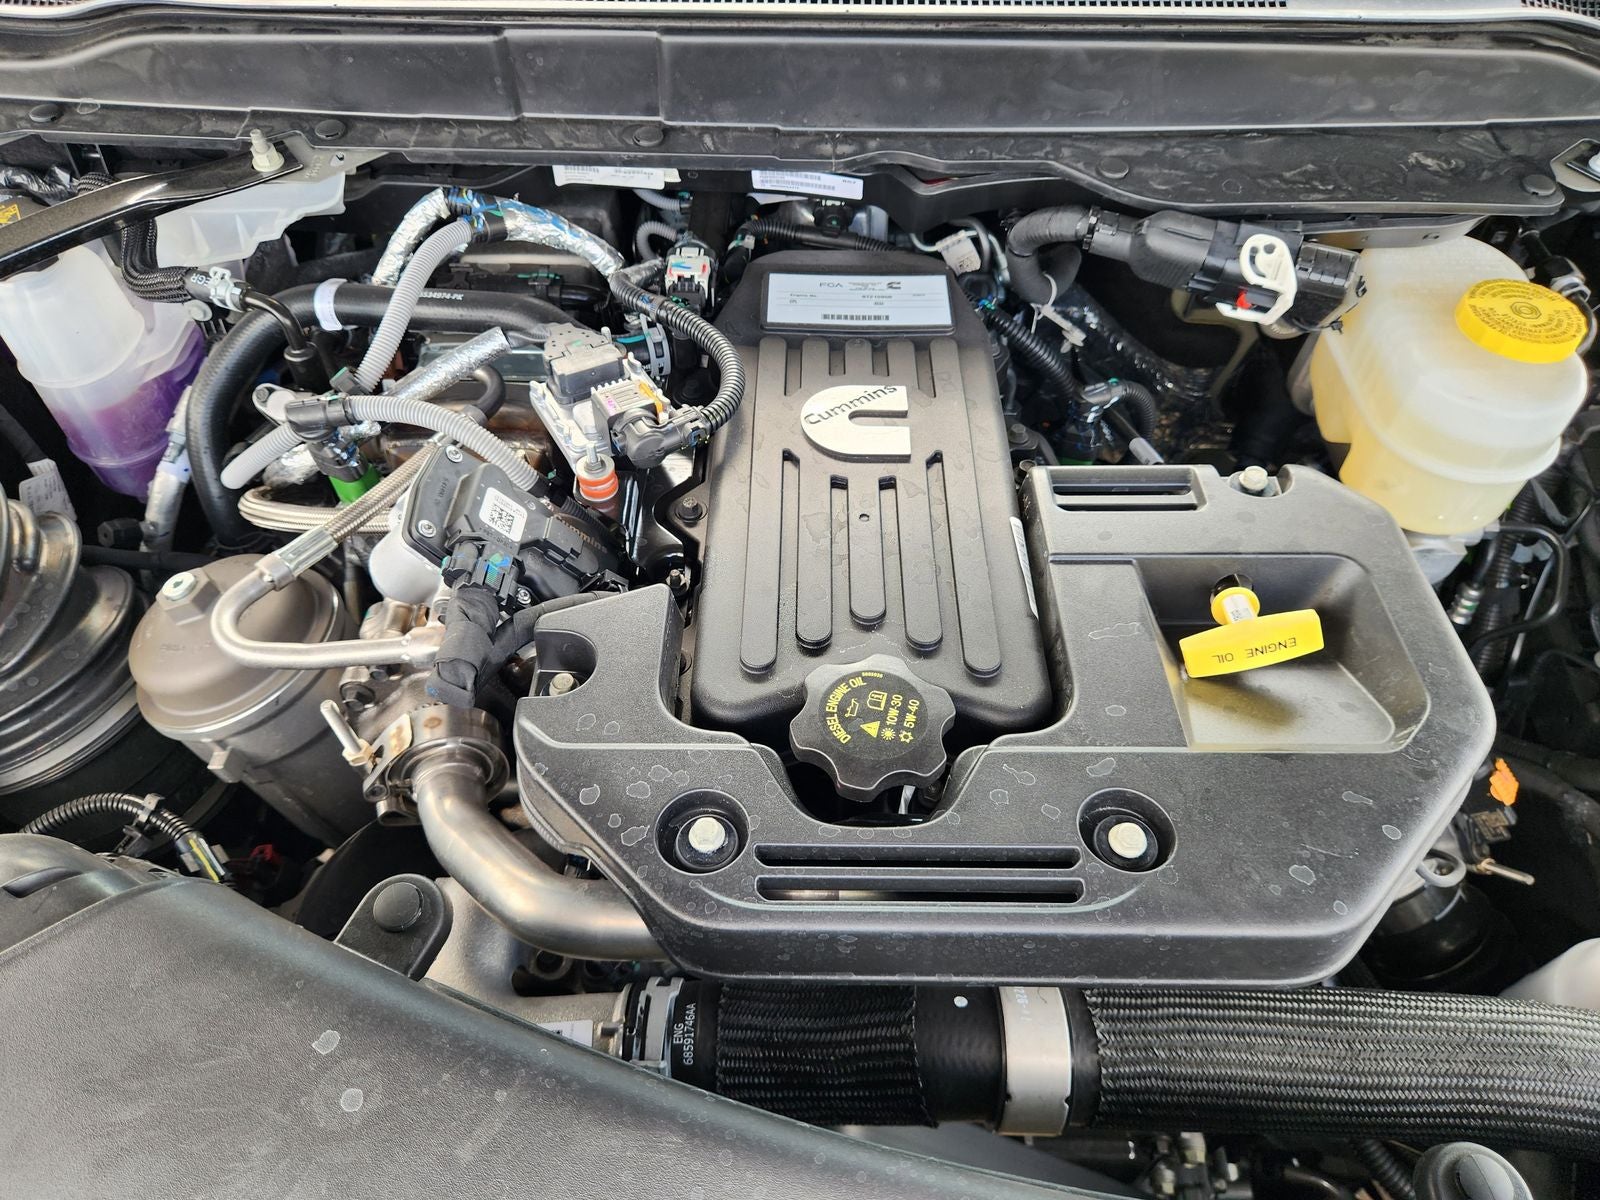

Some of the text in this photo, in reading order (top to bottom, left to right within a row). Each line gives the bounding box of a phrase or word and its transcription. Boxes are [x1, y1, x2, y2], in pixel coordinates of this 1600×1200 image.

[803, 385, 898, 425] Cummins
[1212, 637, 1297, 664] ENGINE OIL
[825, 676, 867, 744] DIESEL ENGINE OIL
[885, 694, 904, 726] 10W-30
[903, 699, 920, 729] 5W-40
[672, 1022, 685, 1045] ENG
[682, 1002, 697, 1066] 68591746AA
